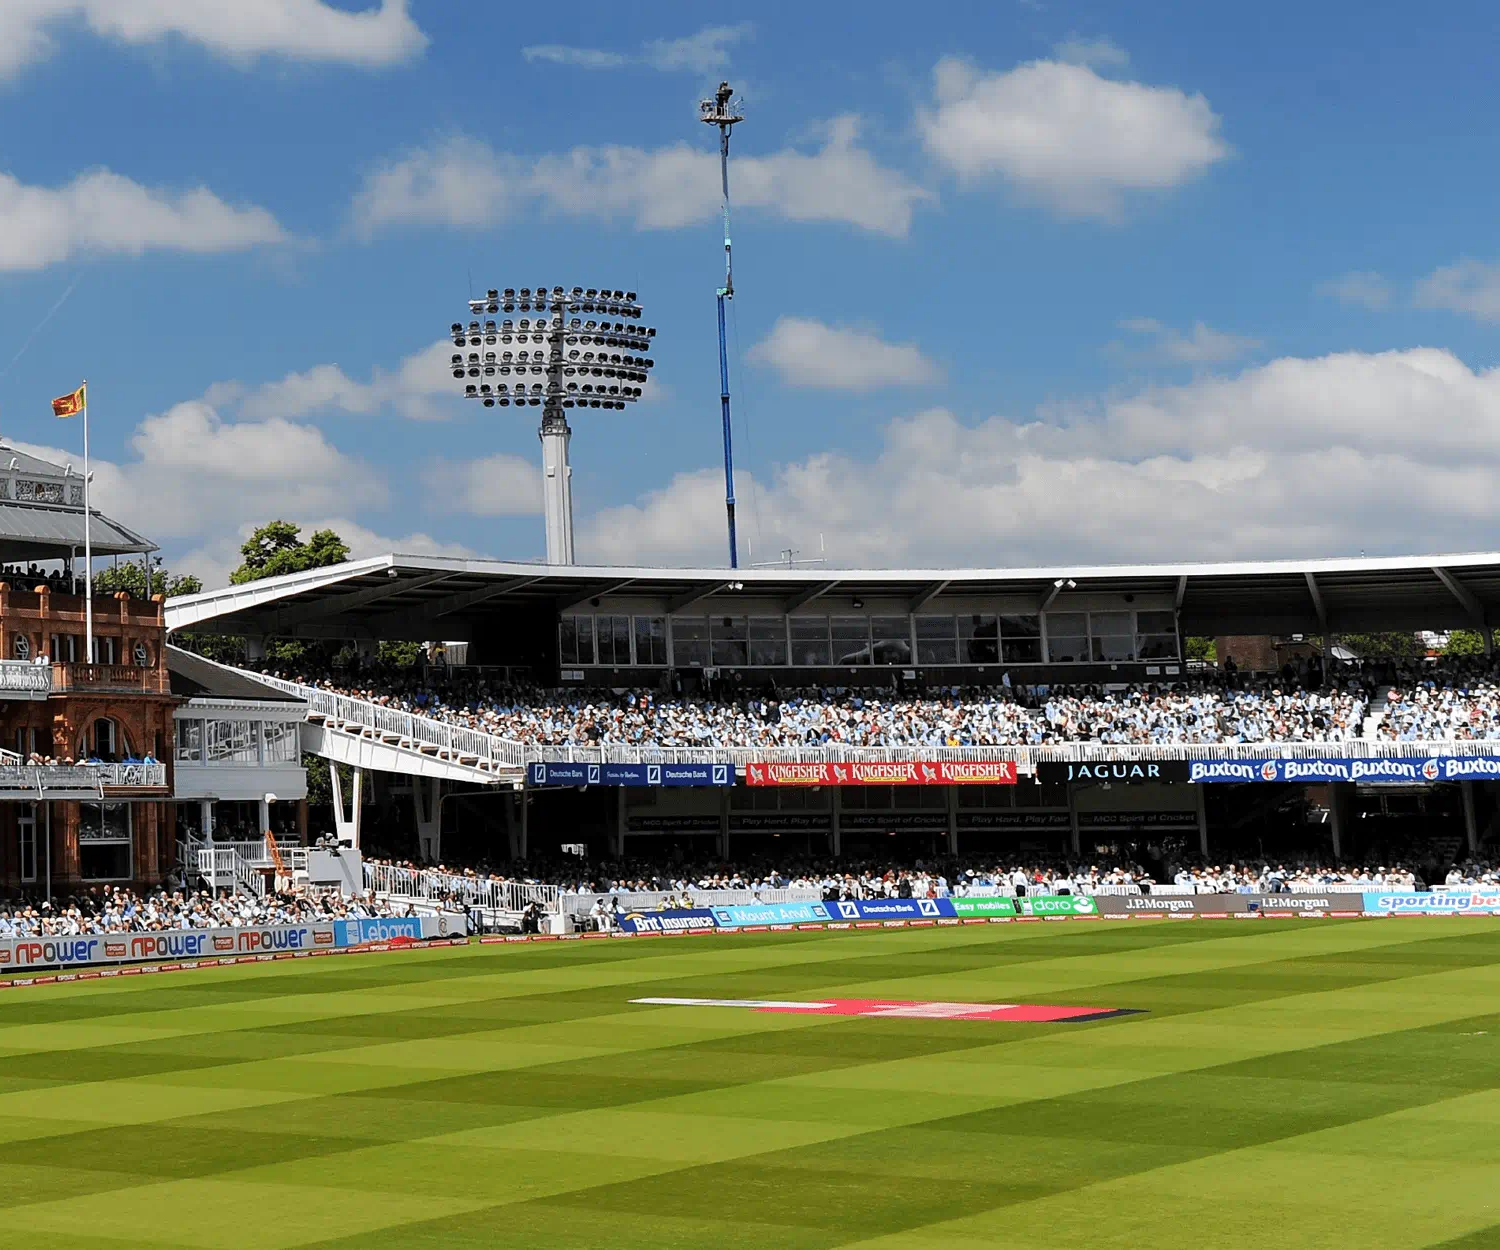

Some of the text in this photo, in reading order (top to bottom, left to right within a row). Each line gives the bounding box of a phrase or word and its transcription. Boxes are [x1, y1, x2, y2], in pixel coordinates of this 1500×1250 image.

[549, 770, 583, 778] Deutsche Bank
[768, 764, 830, 781] KINGFISHER
[852, 763, 919, 780] KINGFISHER
[941, 762, 1012, 780] KINGFISHER
[1067, 764, 1161, 781] JAGUAR
[1191, 760, 1255, 780] Buxton
[1284, 760, 1348, 779] Buxton
[1351, 759, 1416, 779] Buxton
[1444, 757, 1500, 774] Buxto
[665, 770, 707, 779] Deutsche Bank
[863, 904, 915, 914] Deutsche Bank
[955, 902, 1011, 912] Easy mobiles
[1034, 896, 1071, 912] doro
[1125, 899, 1194, 911] J.P.Morgan
[1380, 894, 1500, 908] sportingbe
[634, 911, 714, 932] Brit Insurance
[734, 906, 811, 921] Mount Anvil
[238, 928, 308, 951] npower
[359, 920, 415, 943] Lebara
[15, 940, 98, 965] npower
[131, 934, 206, 958] npower
